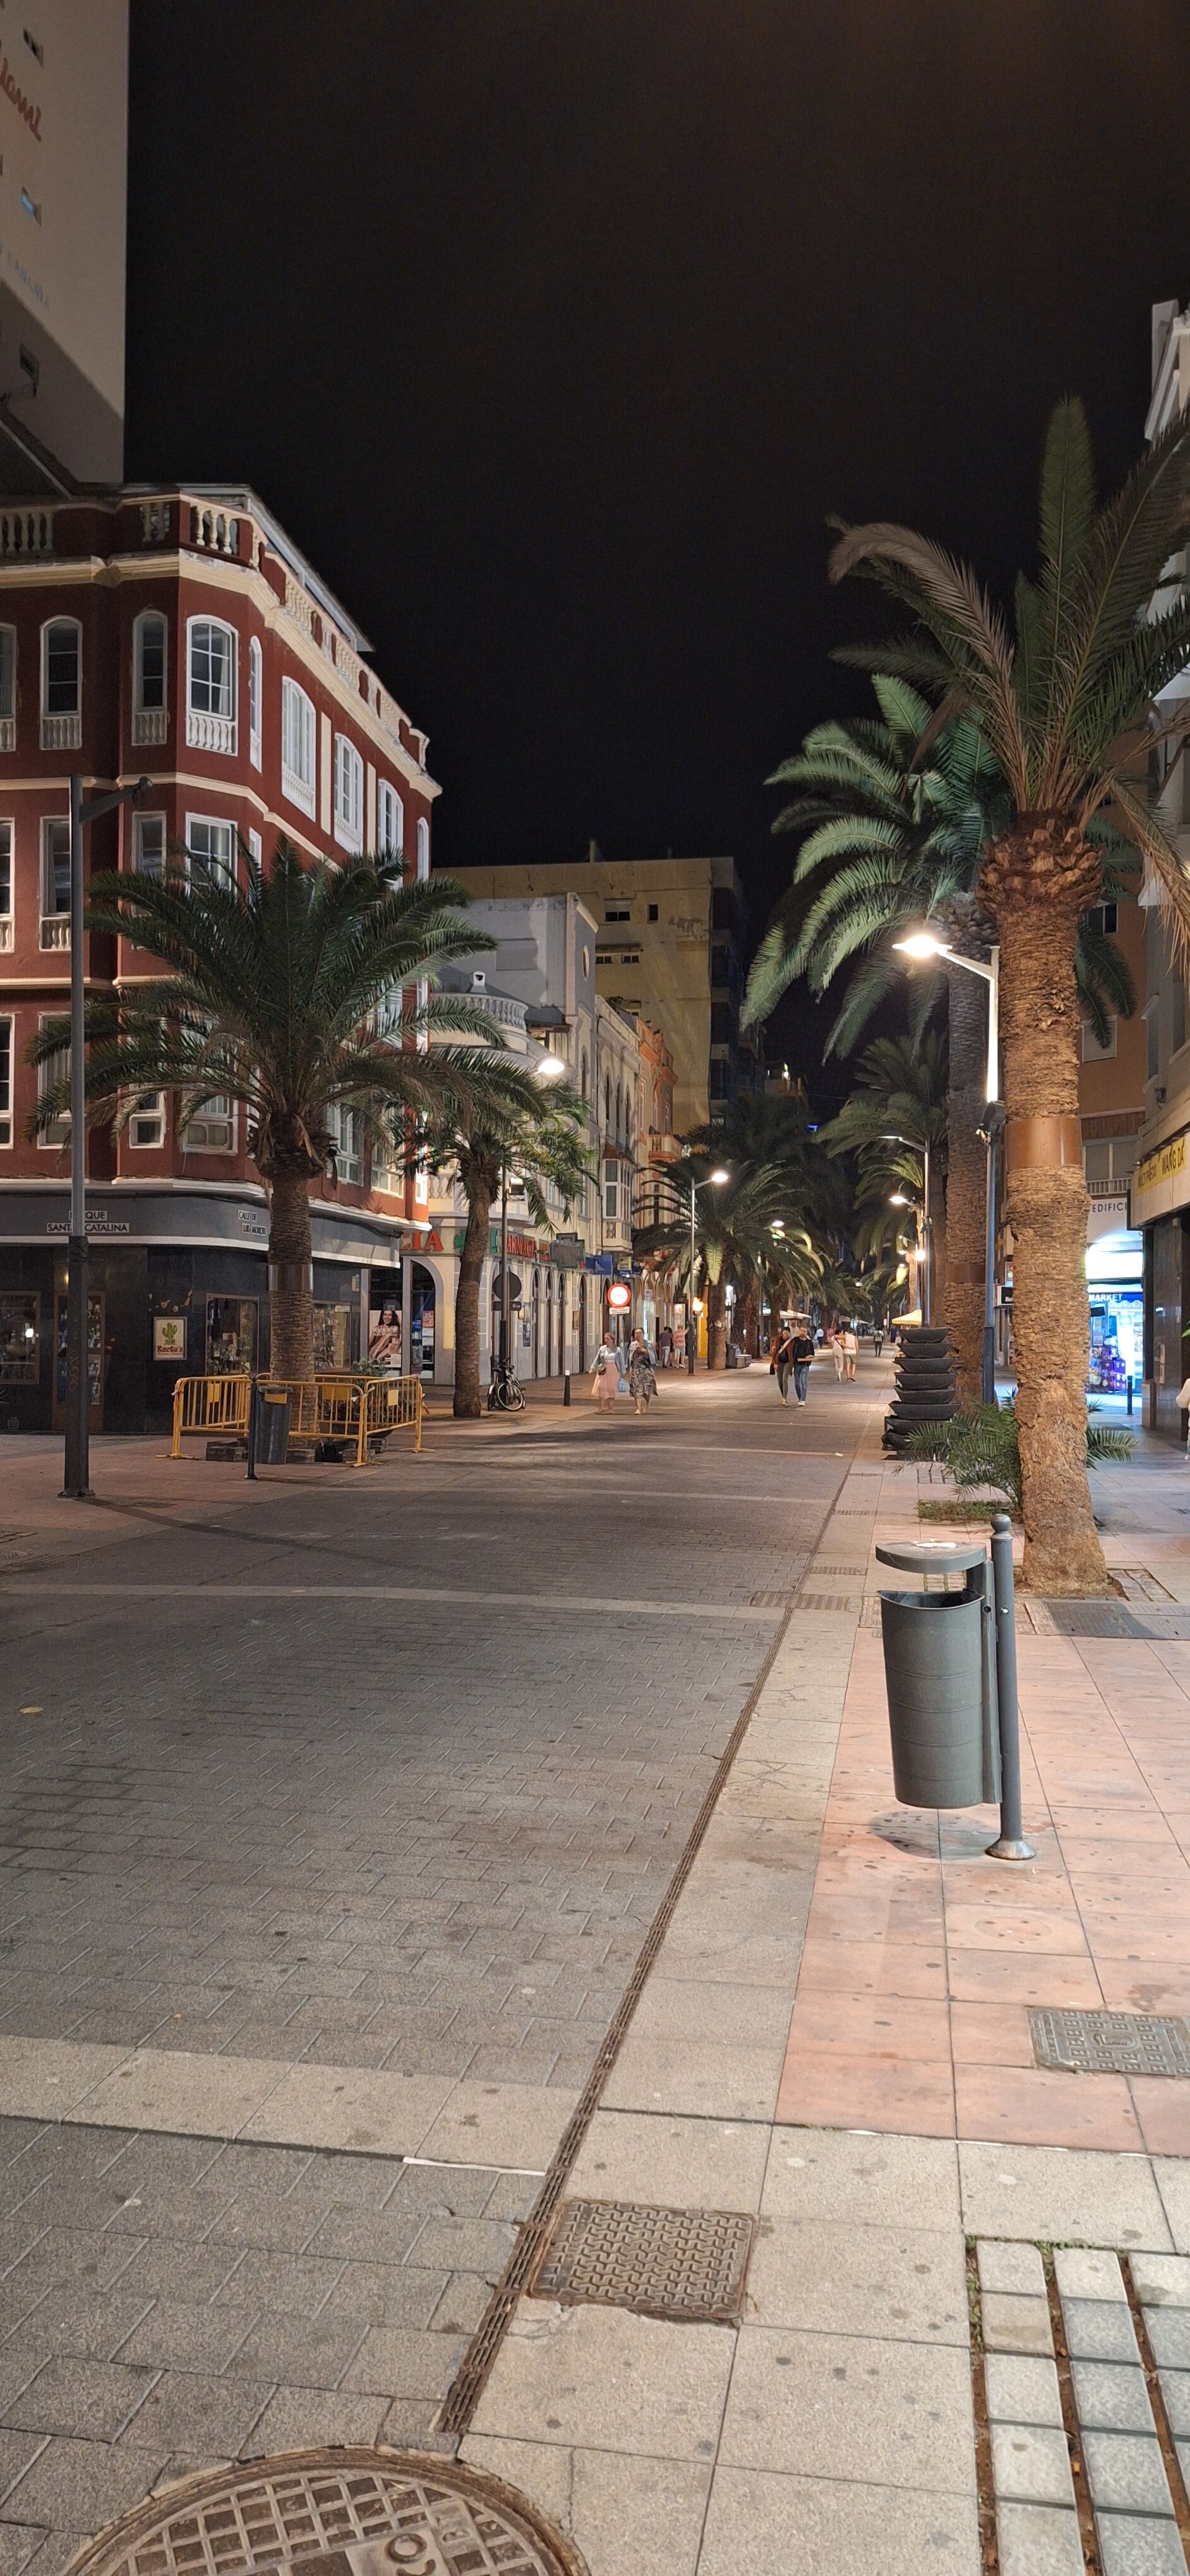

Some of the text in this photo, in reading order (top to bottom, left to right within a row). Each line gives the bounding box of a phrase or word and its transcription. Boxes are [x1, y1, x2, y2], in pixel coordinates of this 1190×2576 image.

[1162, 1149, 1176, 1175] WANG
[1092, 1202, 1127, 1213] EDIFICI
[47, 1224, 127, 1232] SANT CATALINA
[501, 1234, 538, 1258] ARMACIA
[1088, 1293, 1122, 1302] MARKET
